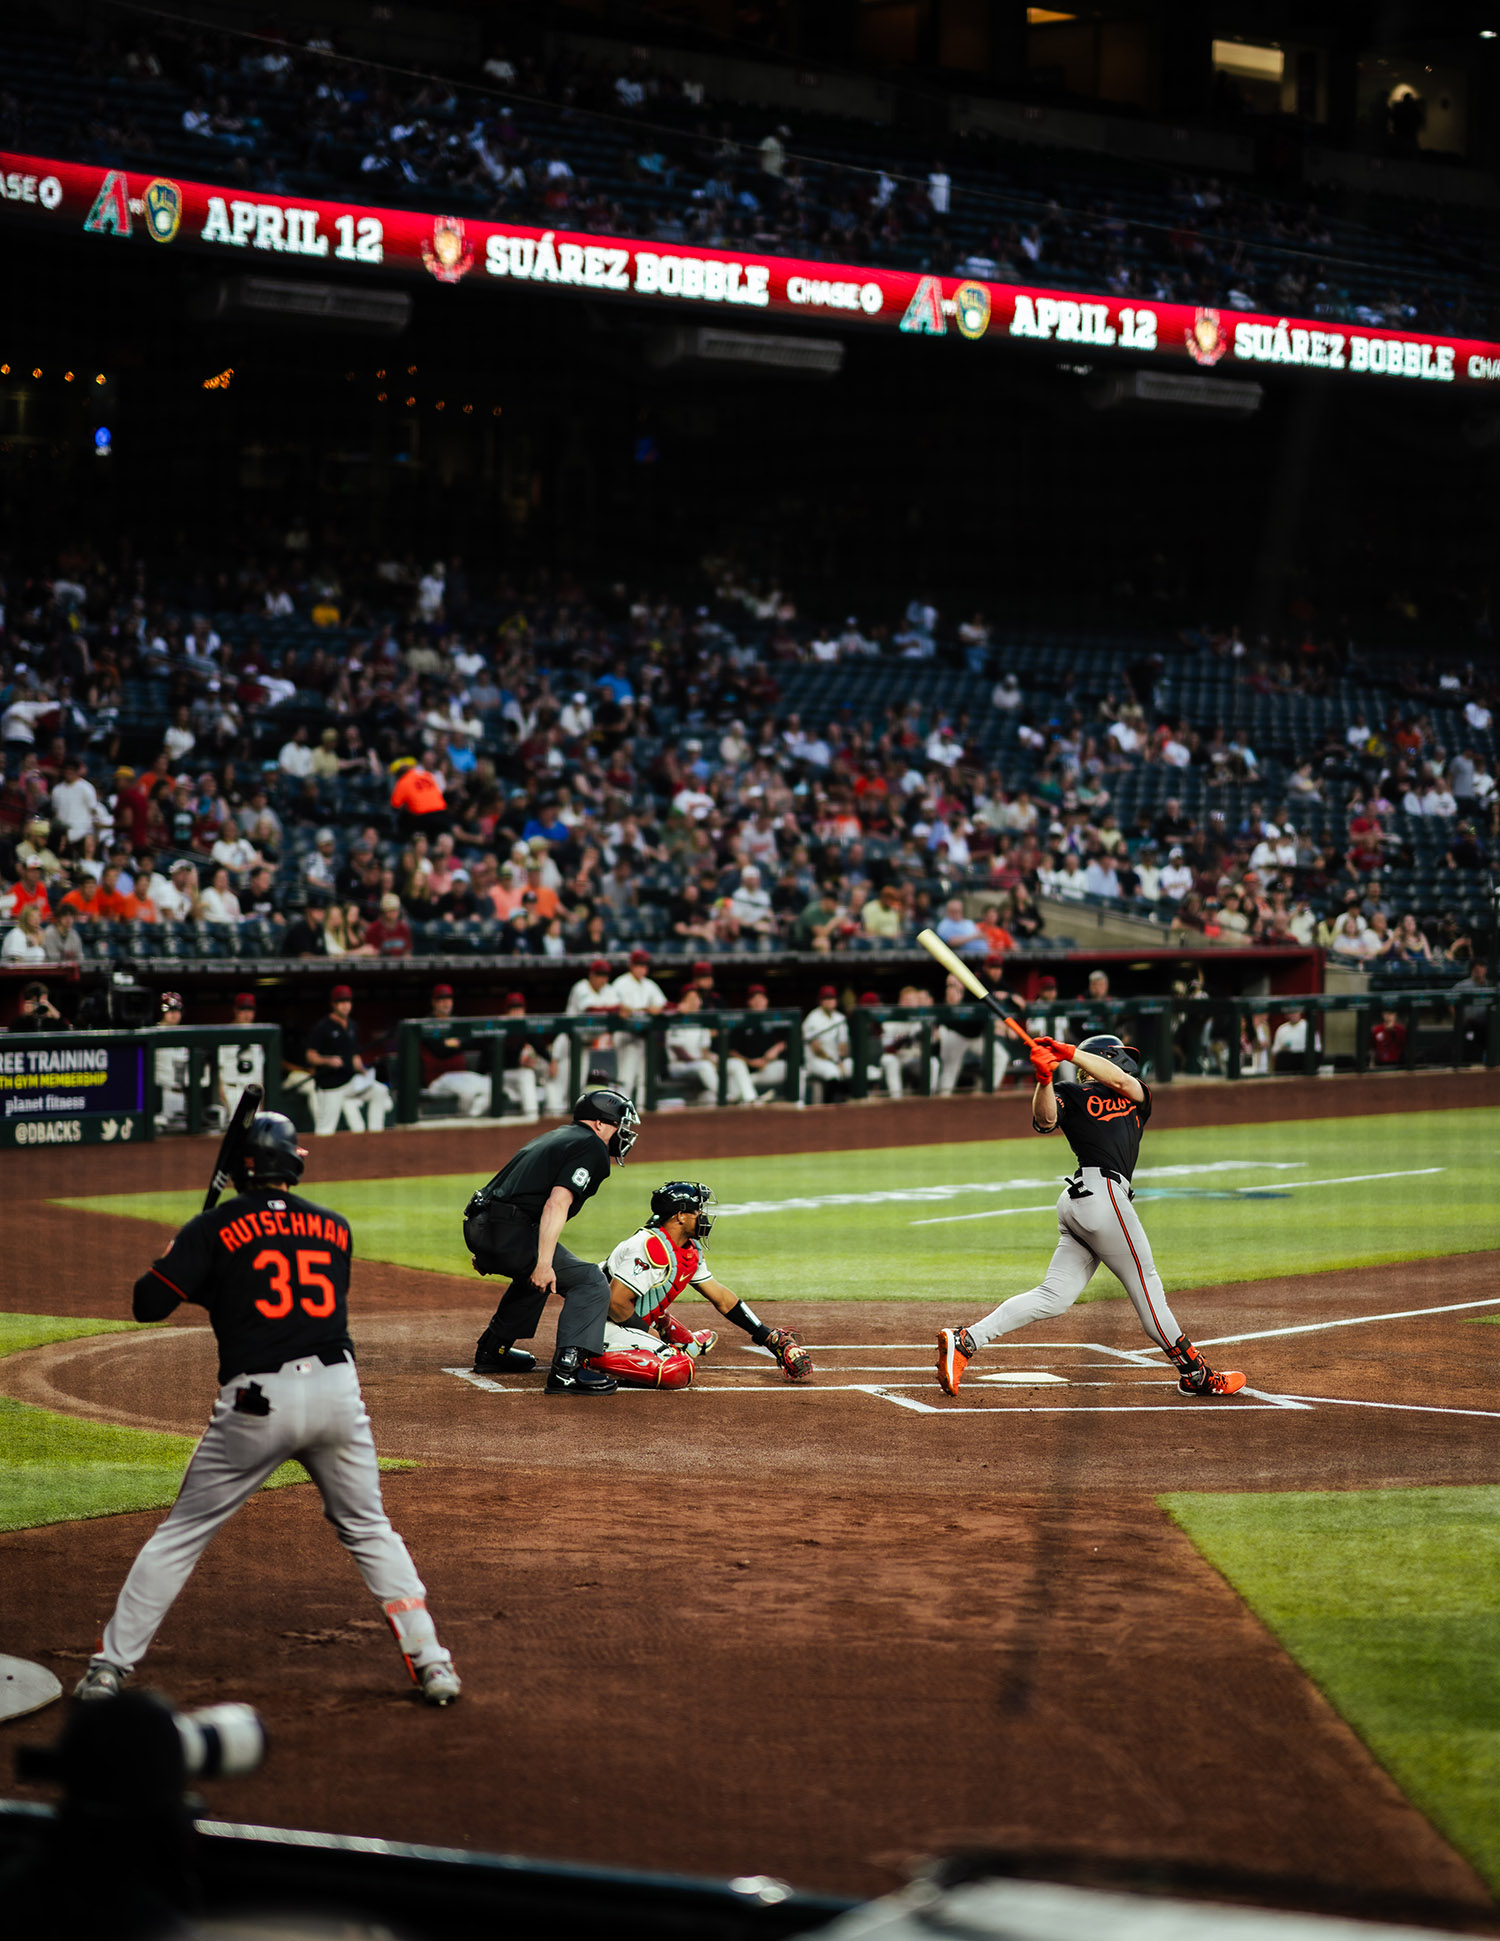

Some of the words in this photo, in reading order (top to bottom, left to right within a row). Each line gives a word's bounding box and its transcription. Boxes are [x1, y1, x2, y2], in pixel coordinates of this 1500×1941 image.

[201, 196, 329, 257] APRIL
[334, 214, 384, 264] 12
[485, 231, 630, 291] SUÁREZ
[634, 251, 770, 307] BOBBLE
[1009, 294, 1117, 347] APRIL
[1118, 307, 1158, 351] 12
[1233, 318, 1346, 370] SUÁREZ
[1349, 335, 1456, 382] BOBBLE
[14, 1073, 39, 1090] GYM
[39, 1071, 108, 1089] MEMBERSHIP
[26, 1049, 108, 1072] TRAINING
[5, 1095, 43, 1117] planet
[45, 1094, 86, 1111] fitness
[14, 1120, 82, 1145] @DBACKS
[218, 1210, 349, 1253] RUTSCHMAN
[252, 1249, 337, 1319] 35
